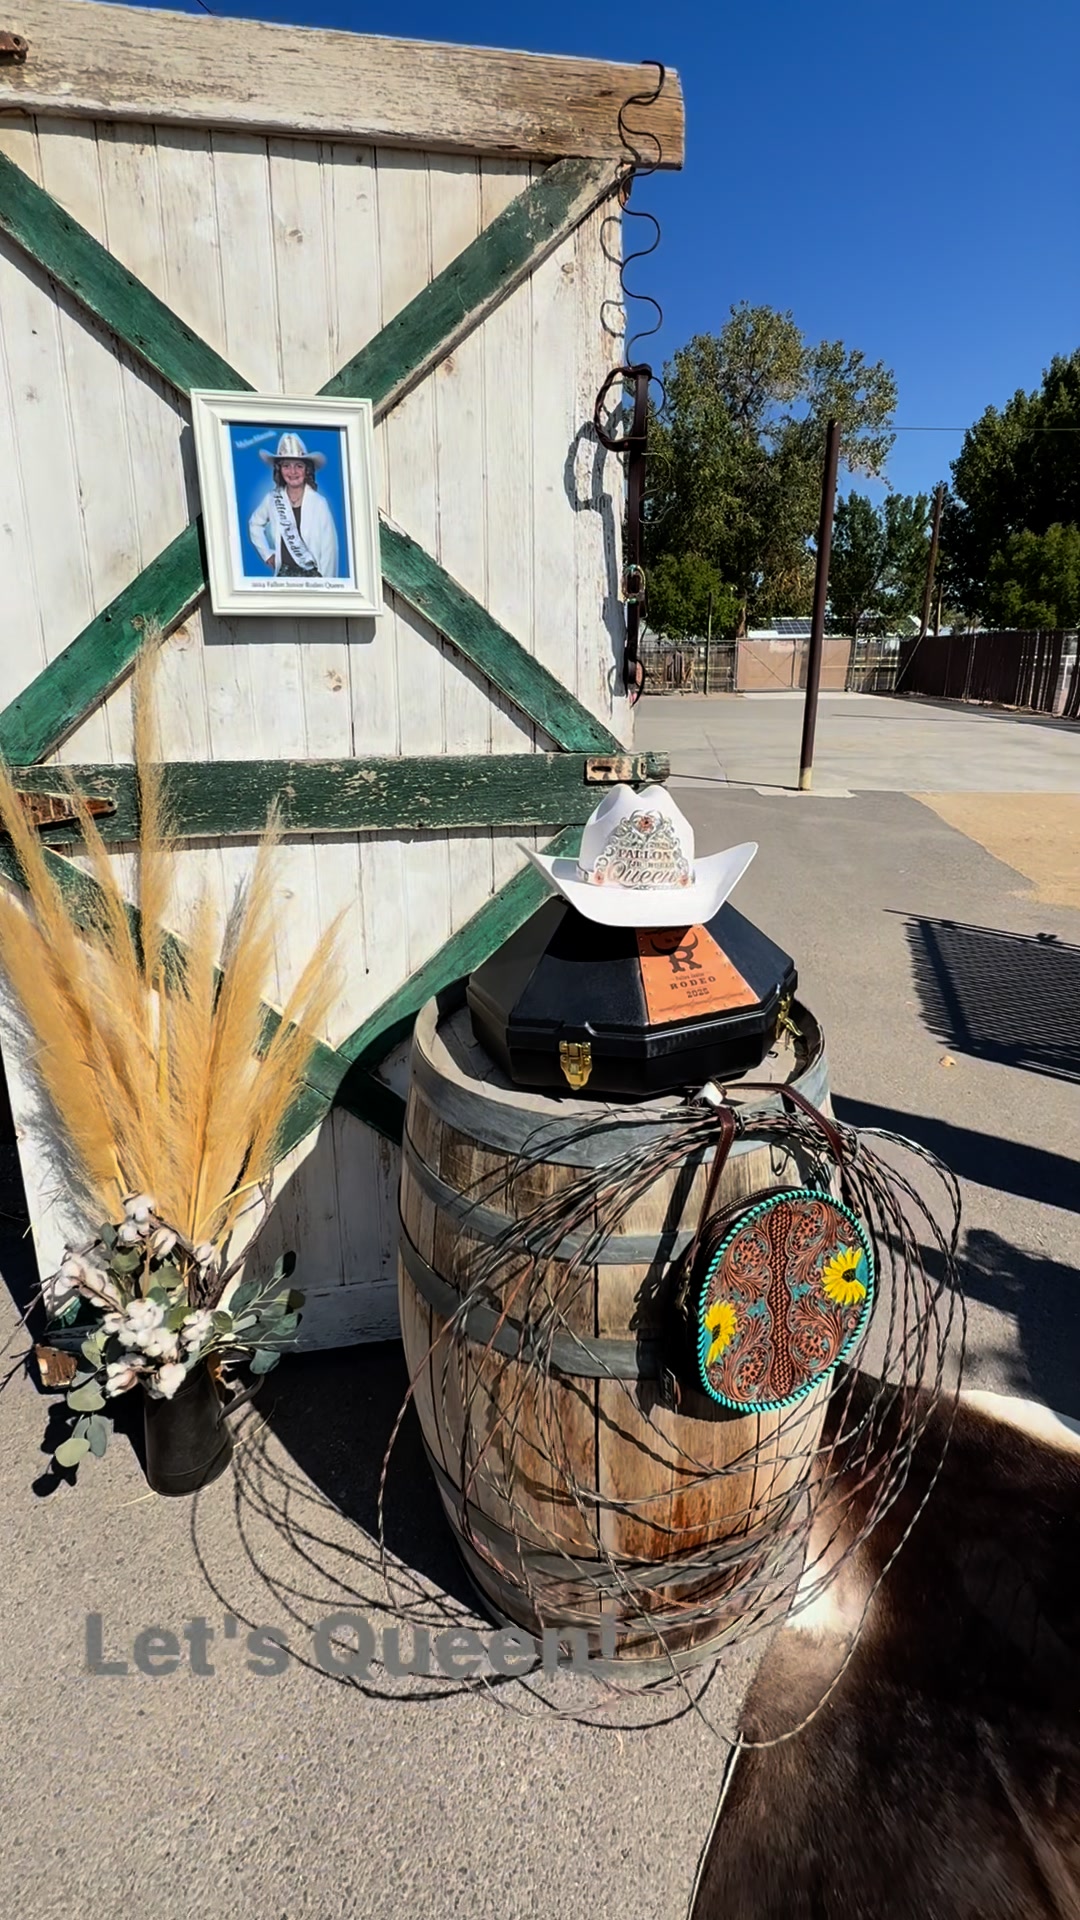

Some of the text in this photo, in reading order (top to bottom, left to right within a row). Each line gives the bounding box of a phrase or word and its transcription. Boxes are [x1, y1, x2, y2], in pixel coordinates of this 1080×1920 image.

[325, 581, 345, 589] Queen
[608, 860, 678, 888] Queen
[669, 975, 717, 991] RODEO
